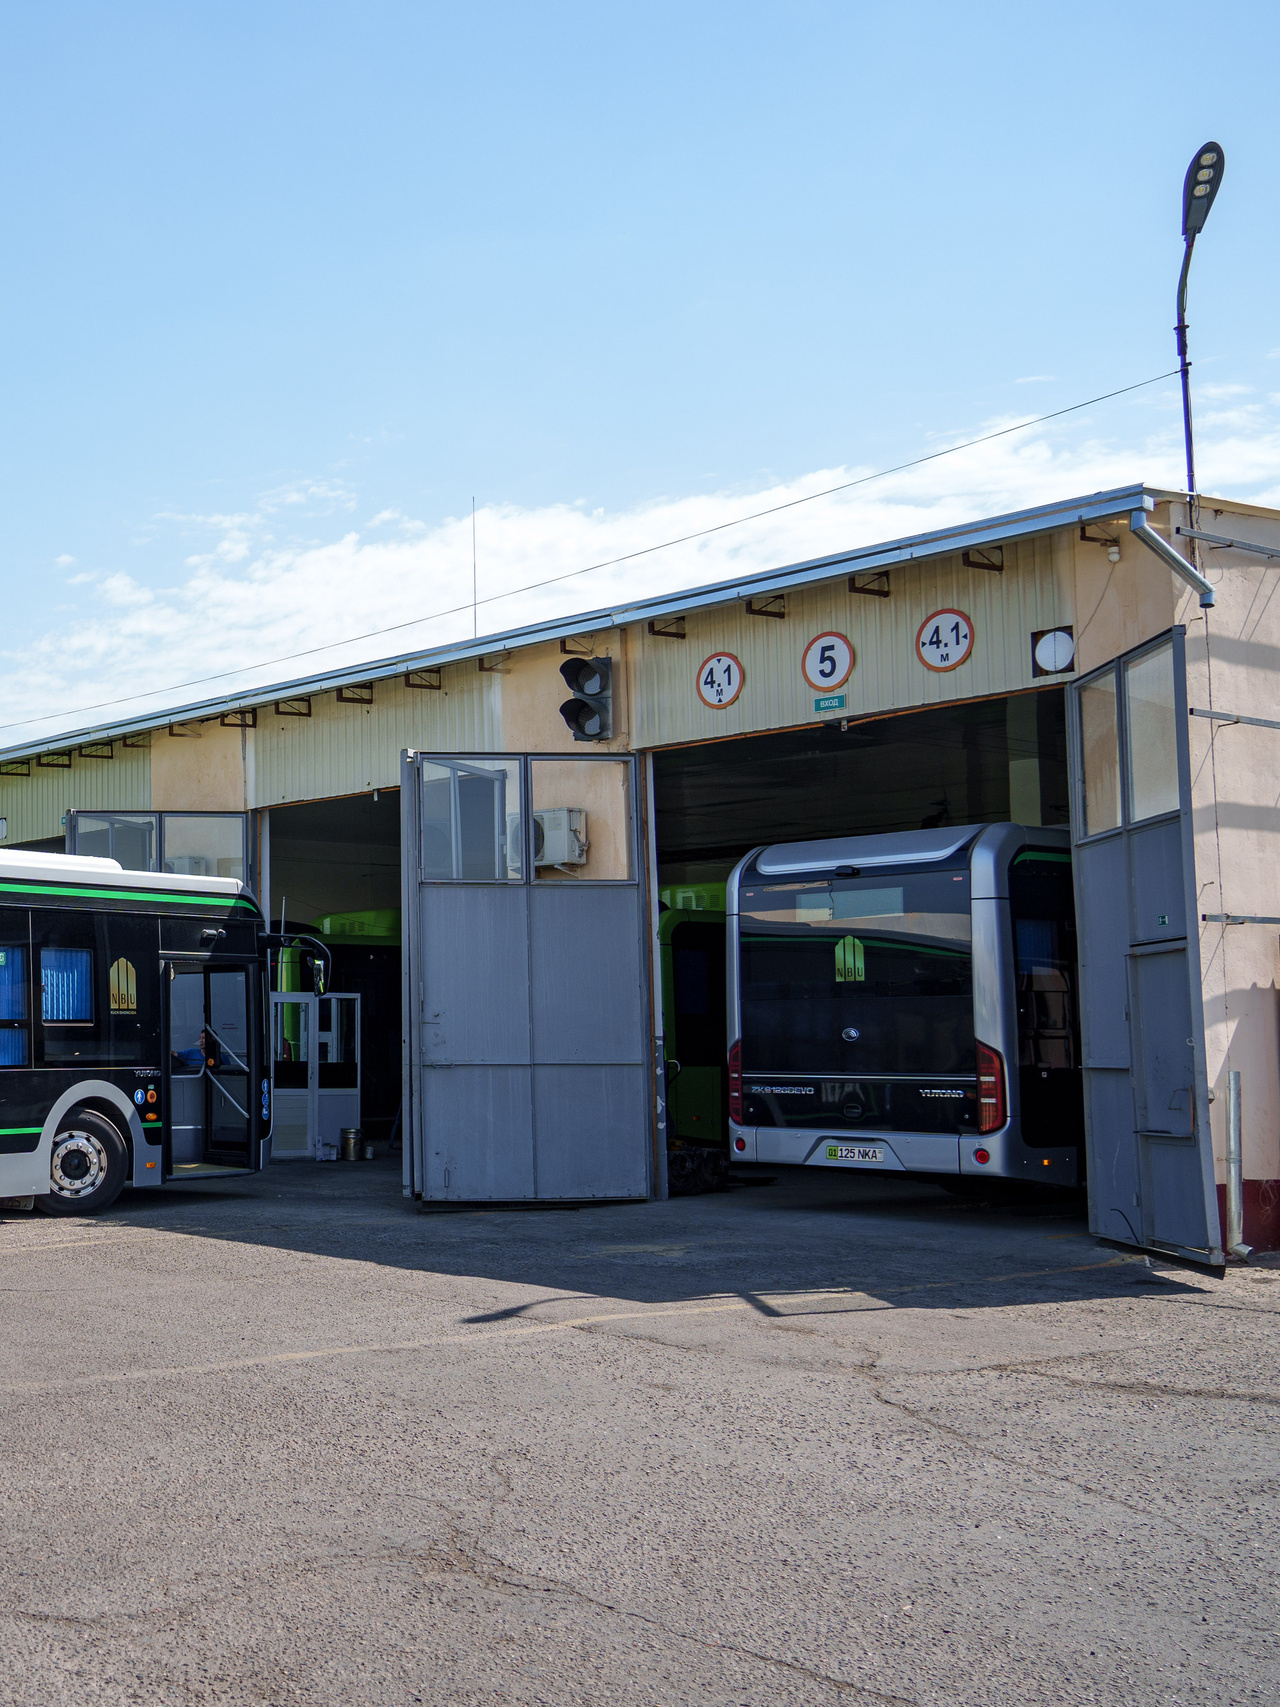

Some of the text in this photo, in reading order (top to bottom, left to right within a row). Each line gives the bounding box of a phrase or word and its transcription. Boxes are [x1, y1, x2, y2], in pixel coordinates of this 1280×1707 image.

[928, 621, 961, 650] 4.1
[819, 644, 837, 679] 5
[703, 663, 732, 689] 4.1
[820, 699, 839, 708] ВХОД
[836, 966, 864, 978] NBU
[111, 993, 136, 1005] NBU
[838, 1147, 856, 1160] 125
[857, 1149, 878, 1160] NKA
